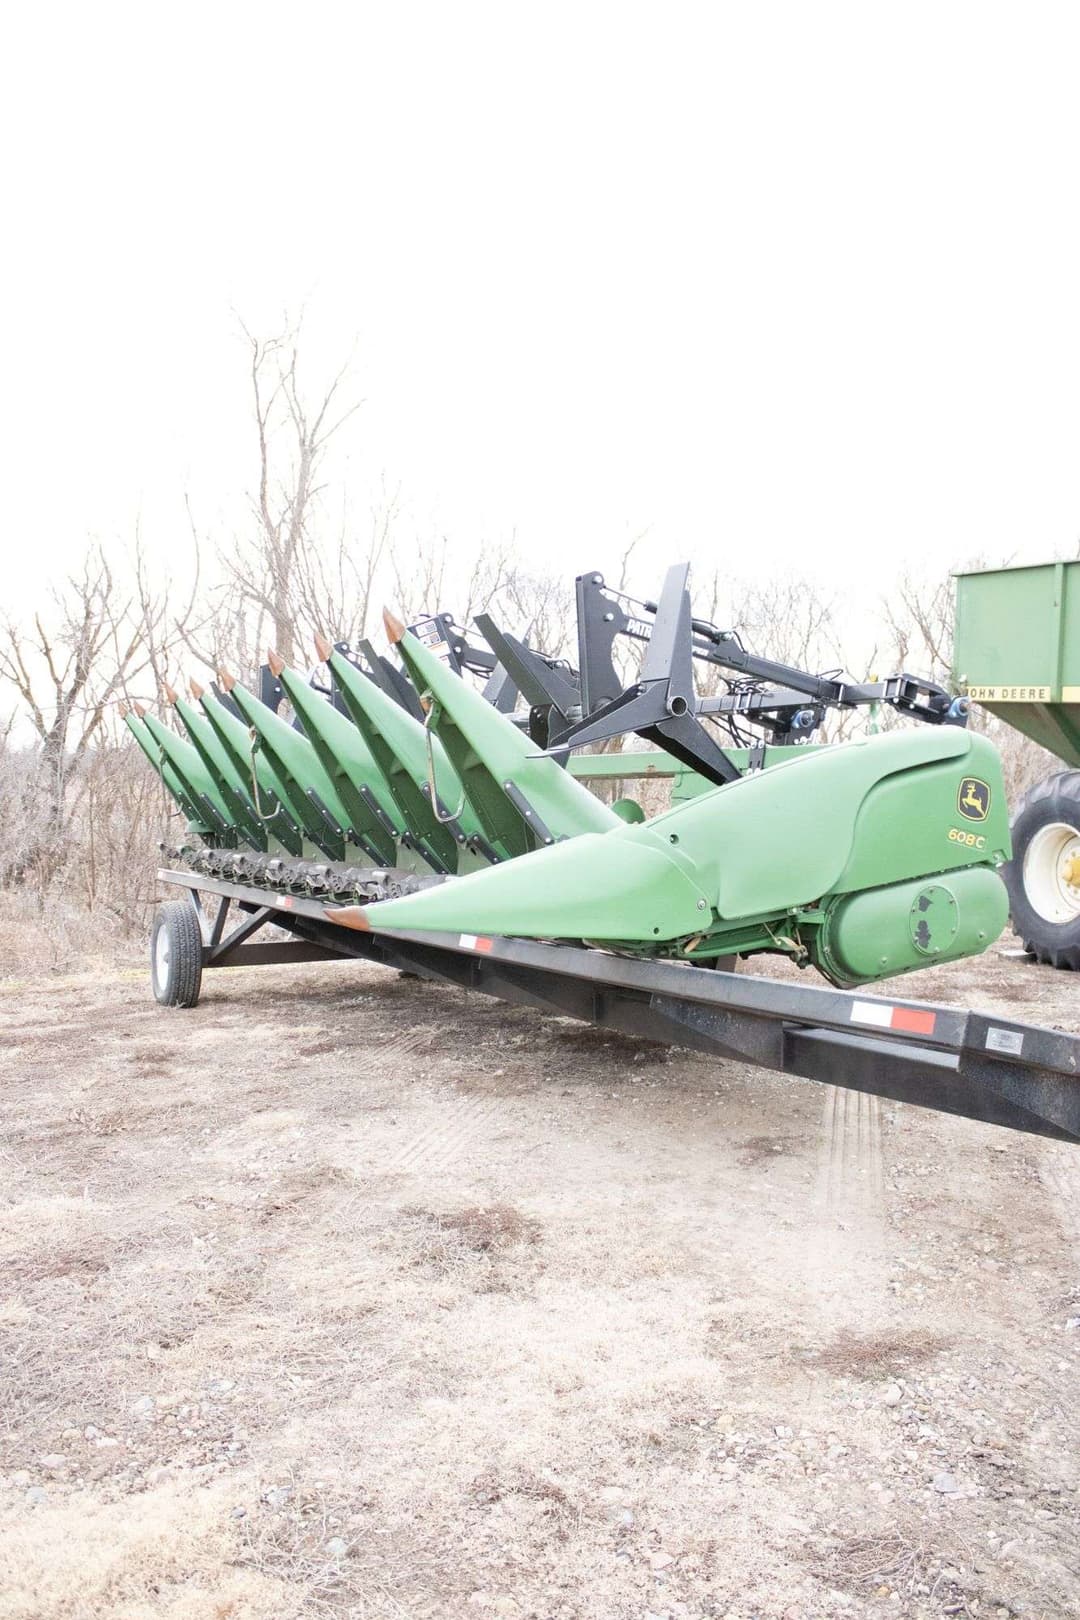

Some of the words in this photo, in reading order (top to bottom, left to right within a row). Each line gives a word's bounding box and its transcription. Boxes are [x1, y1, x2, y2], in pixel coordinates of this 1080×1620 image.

[626, 618, 654, 638] PATR
[967, 688, 995, 698] OHN
[1001, 688, 1046, 699] DEERE
[948, 828, 986, 849] 608C
